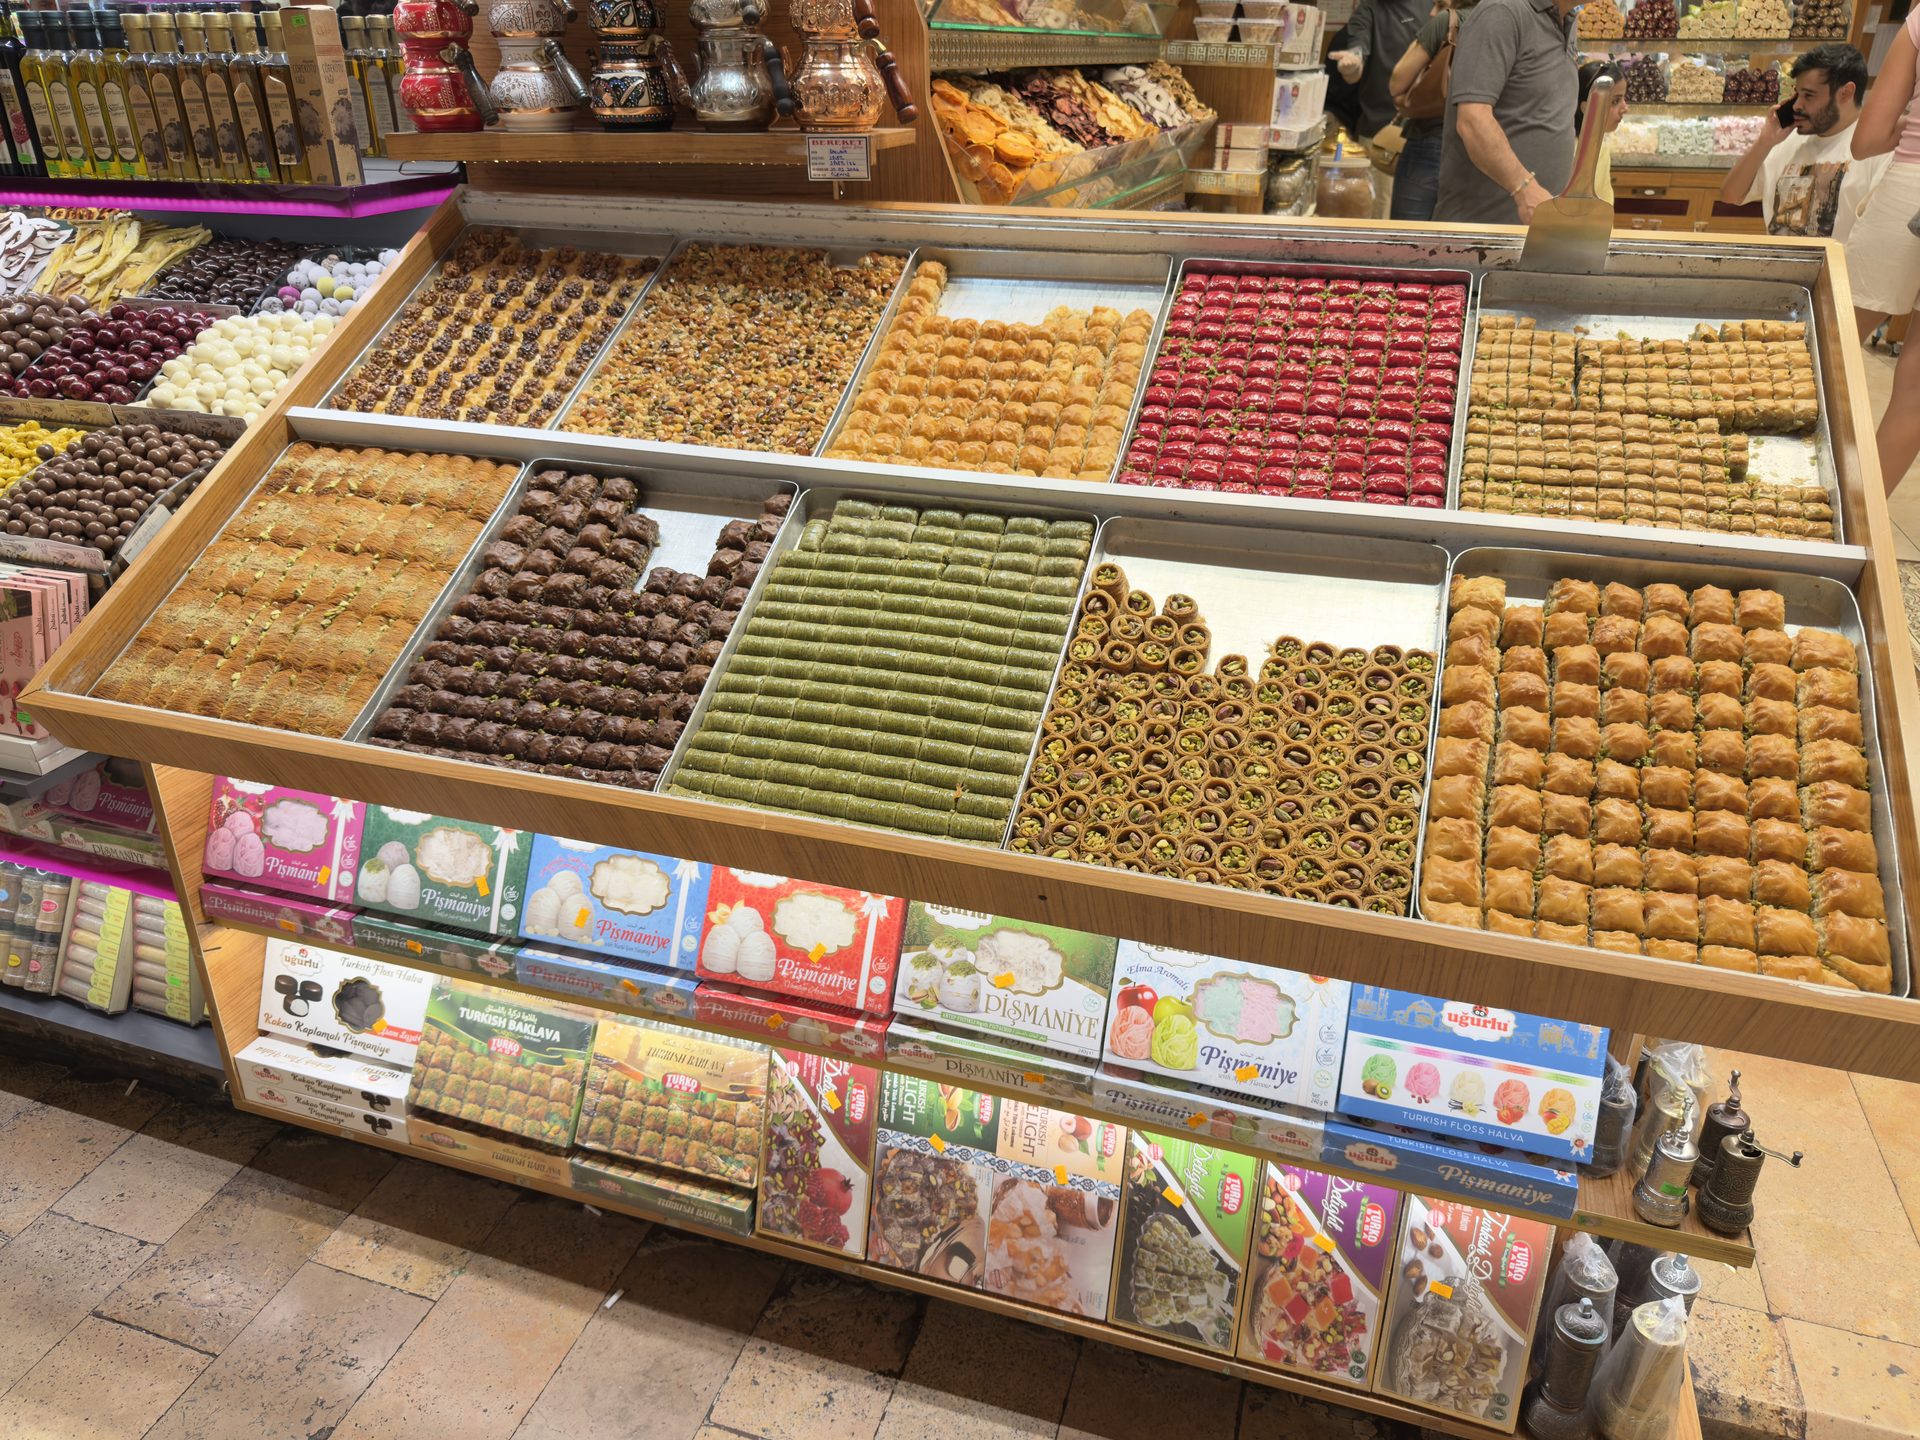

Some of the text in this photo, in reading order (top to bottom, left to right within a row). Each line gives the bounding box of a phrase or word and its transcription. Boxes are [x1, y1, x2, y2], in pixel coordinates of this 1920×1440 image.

[811, 139, 864, 147] BEREKET
[421, 888, 491, 922] Pişmaniye
[596, 919, 671, 954] Pişmaniye
[340, 957, 371, 972] Turkish
[372, 964, 394, 977] Floss
[777, 958, 857, 995] Pişmaniye
[1127, 963, 1153, 974] Elma
[459, 1006, 561, 1043] TURKISH BAKLAVA
[984, 992, 1100, 1041] PİŞMANİYE
[1447, 1011, 1509, 1032] uğurlu
[263, 1012, 292, 1030] Kakao
[294, 1020, 341, 1042] Kaplamalı
[342, 1032, 390, 1057] Pişmaniye
[491, 1038, 520, 1052] TURKO
[647, 1047, 687, 1064] TURKISH
[666, 1074, 698, 1089] TURKO
[916, 1079, 928, 1114] URKISH
[854, 1088, 866, 1119] TURKO
[902, 1077, 918, 1125] LIGHT
[1022, 1103, 1039, 1158] ELIGHT
[1038, 1107, 1049, 1147] TURKISH
[1402, 1110, 1525, 1143] TURKISH FLOSS HALVA
[1388, 1136, 1509, 1168] TURKISH FLOSS HALVA
[1183, 1143, 1215, 1200] Delight
[1438, 1165, 1553, 1206] Pişmaniye
[1227, 1177, 1241, 1212] TURKO
[1321, 1175, 1355, 1232] Delight
[1362, 1208, 1371, 1239] BABA
[1367, 1208, 1383, 1243] TURKO
[1462, 1208, 1511, 1314] Turkish Delight
[1507, 1245, 1518, 1278] BABA
[1512, 1246, 1529, 1281] TURKO
